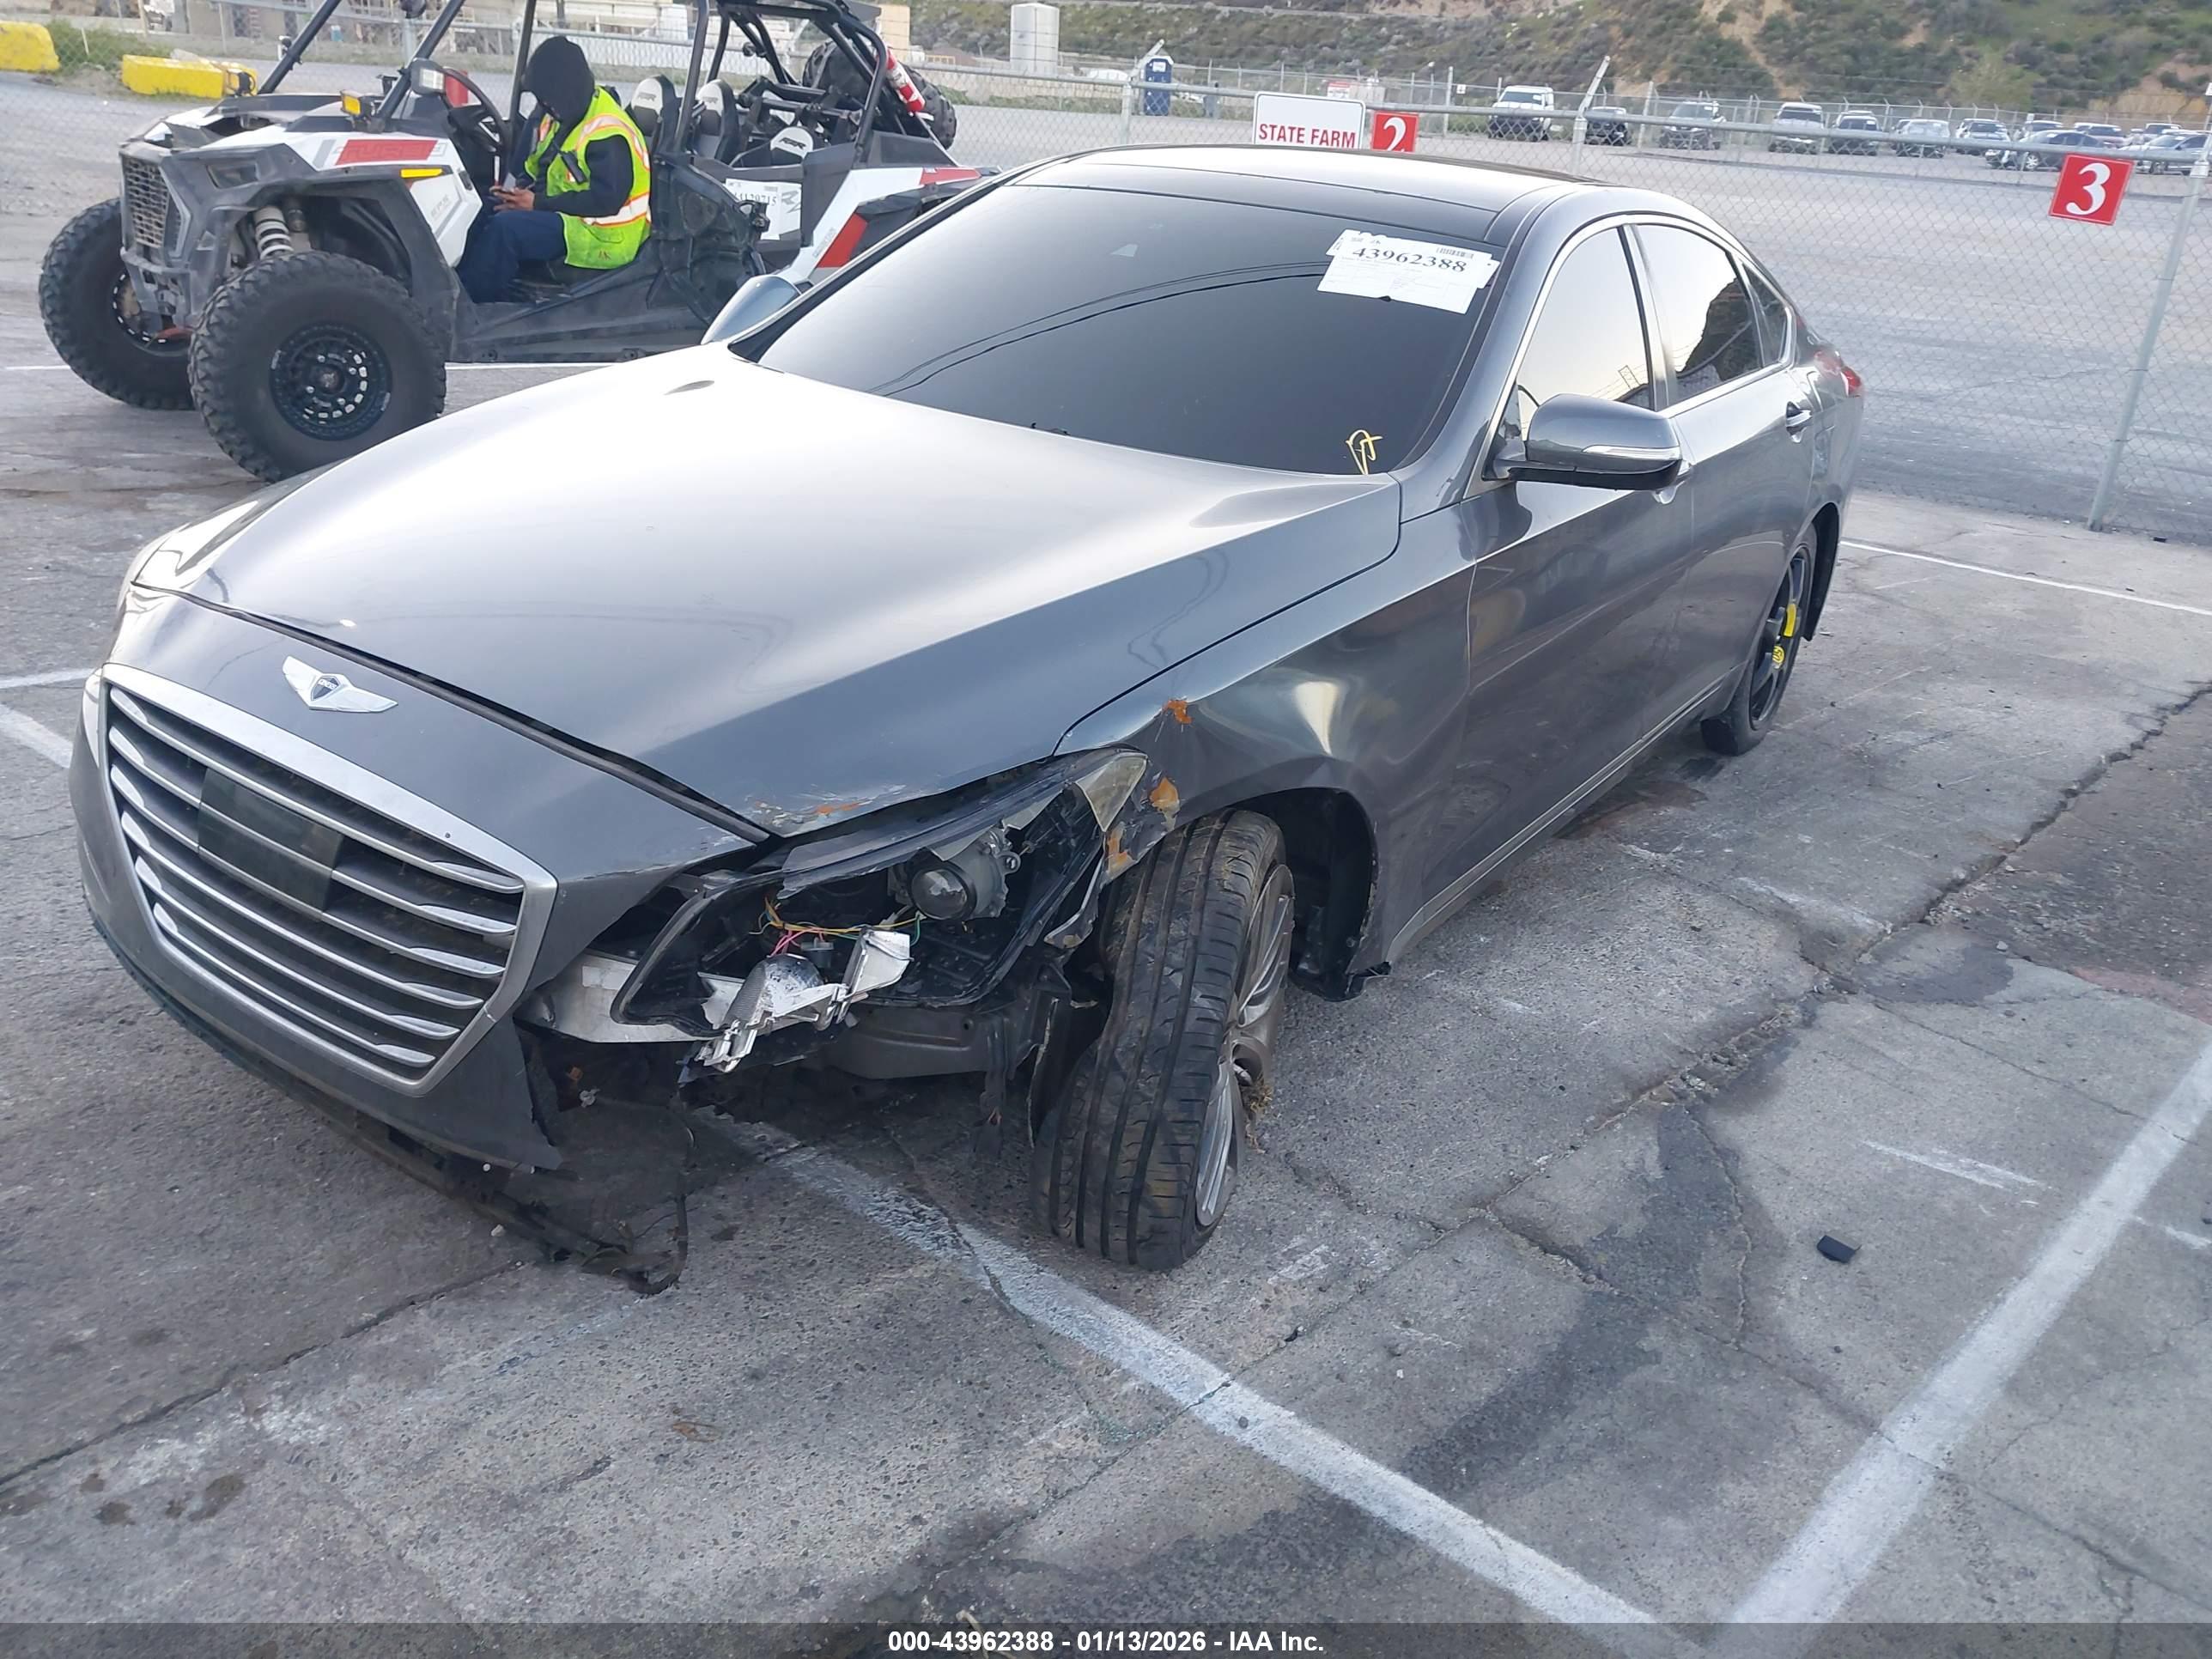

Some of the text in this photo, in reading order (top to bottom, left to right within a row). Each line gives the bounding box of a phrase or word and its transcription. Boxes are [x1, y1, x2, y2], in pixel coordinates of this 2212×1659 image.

[1259, 123, 1357, 148] STATE FARM
[1383, 117, 1407, 152] 2
[2065, 162, 2111, 216] 3
[1352, 247, 1468, 272] 43962388
